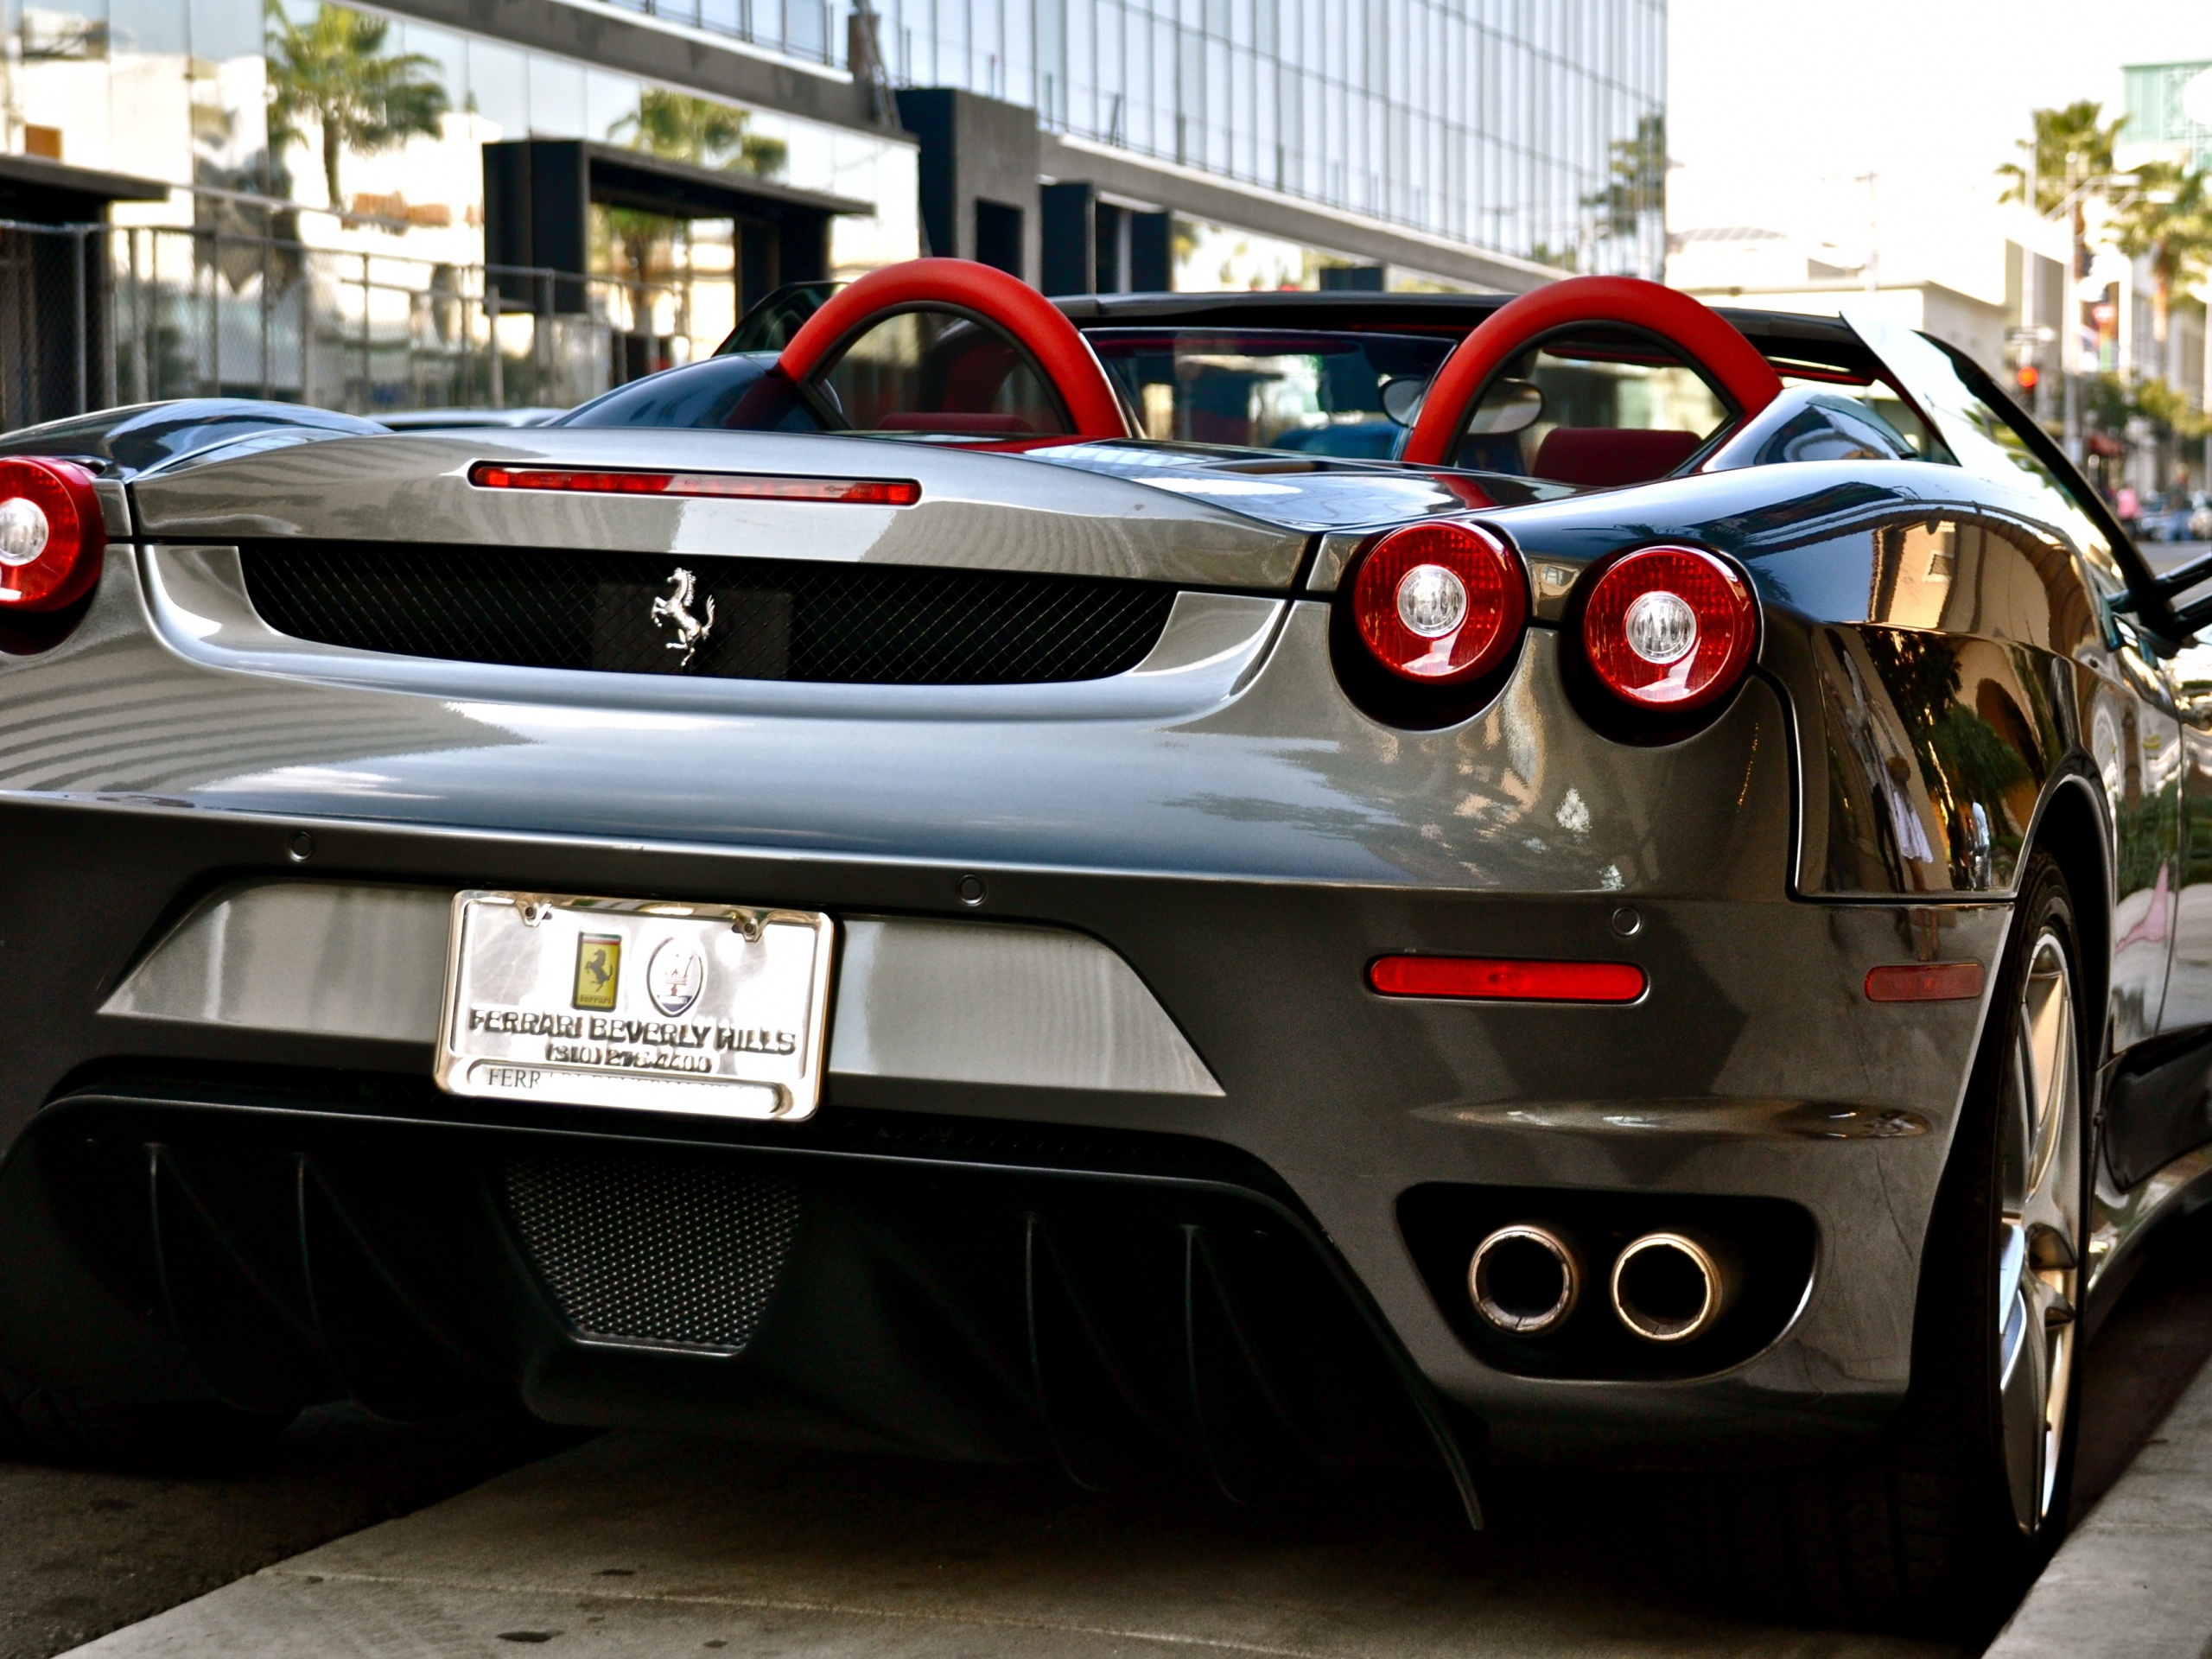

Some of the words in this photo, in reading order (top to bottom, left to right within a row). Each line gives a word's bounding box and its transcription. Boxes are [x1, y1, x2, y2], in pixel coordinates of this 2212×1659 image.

[469, 1009, 584, 1039] FERRARI
[588, 1014, 711, 1049] BEVERLY
[714, 1025, 797, 1056] HILLS
[487, 1067, 553, 1089] FERR
